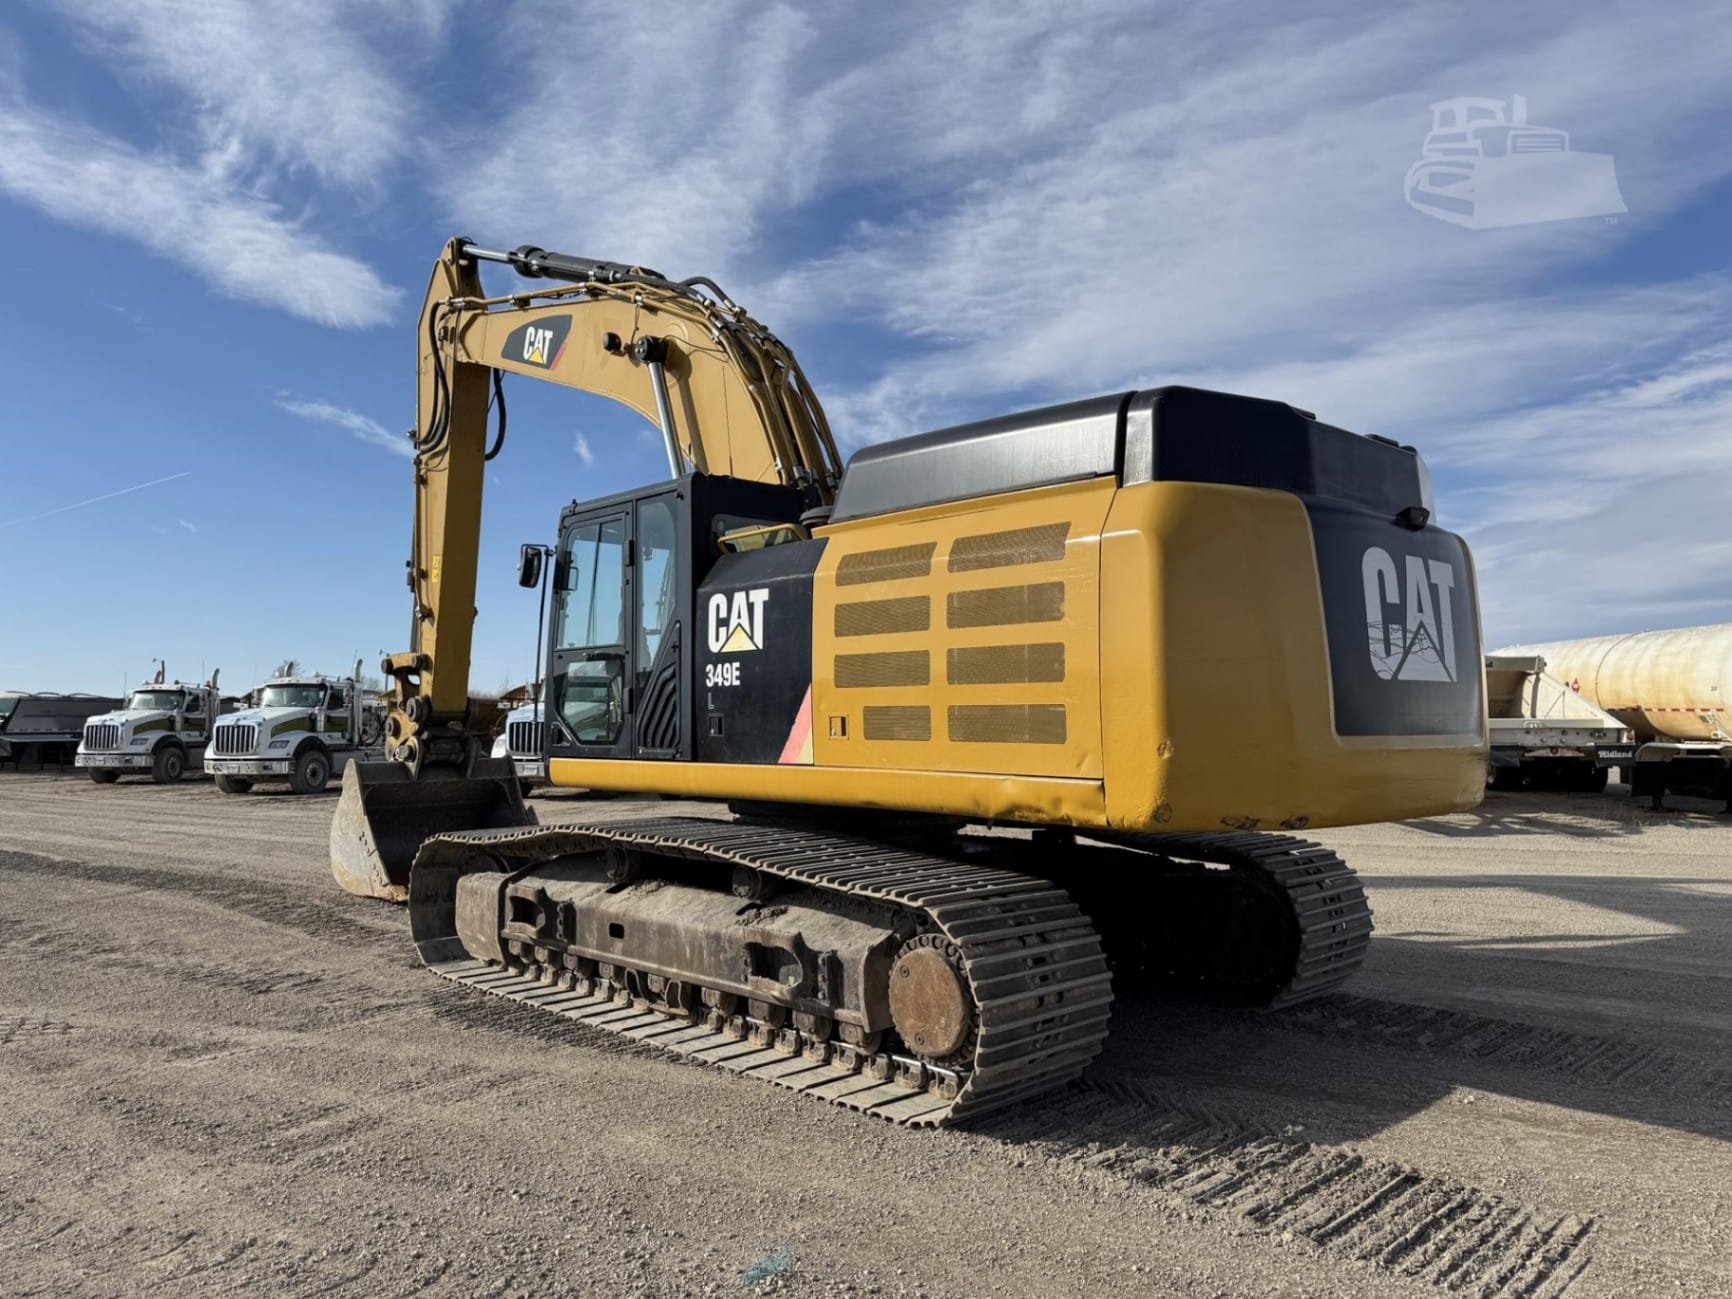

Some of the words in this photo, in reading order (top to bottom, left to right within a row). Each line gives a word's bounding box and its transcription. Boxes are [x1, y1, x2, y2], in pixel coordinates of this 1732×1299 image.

[523, 326, 554, 364] CAT
[708, 588, 769, 653] CAT
[1362, 546, 1457, 682] CAT
[705, 661, 741, 687] 349E
[708, 692, 715, 710] L
